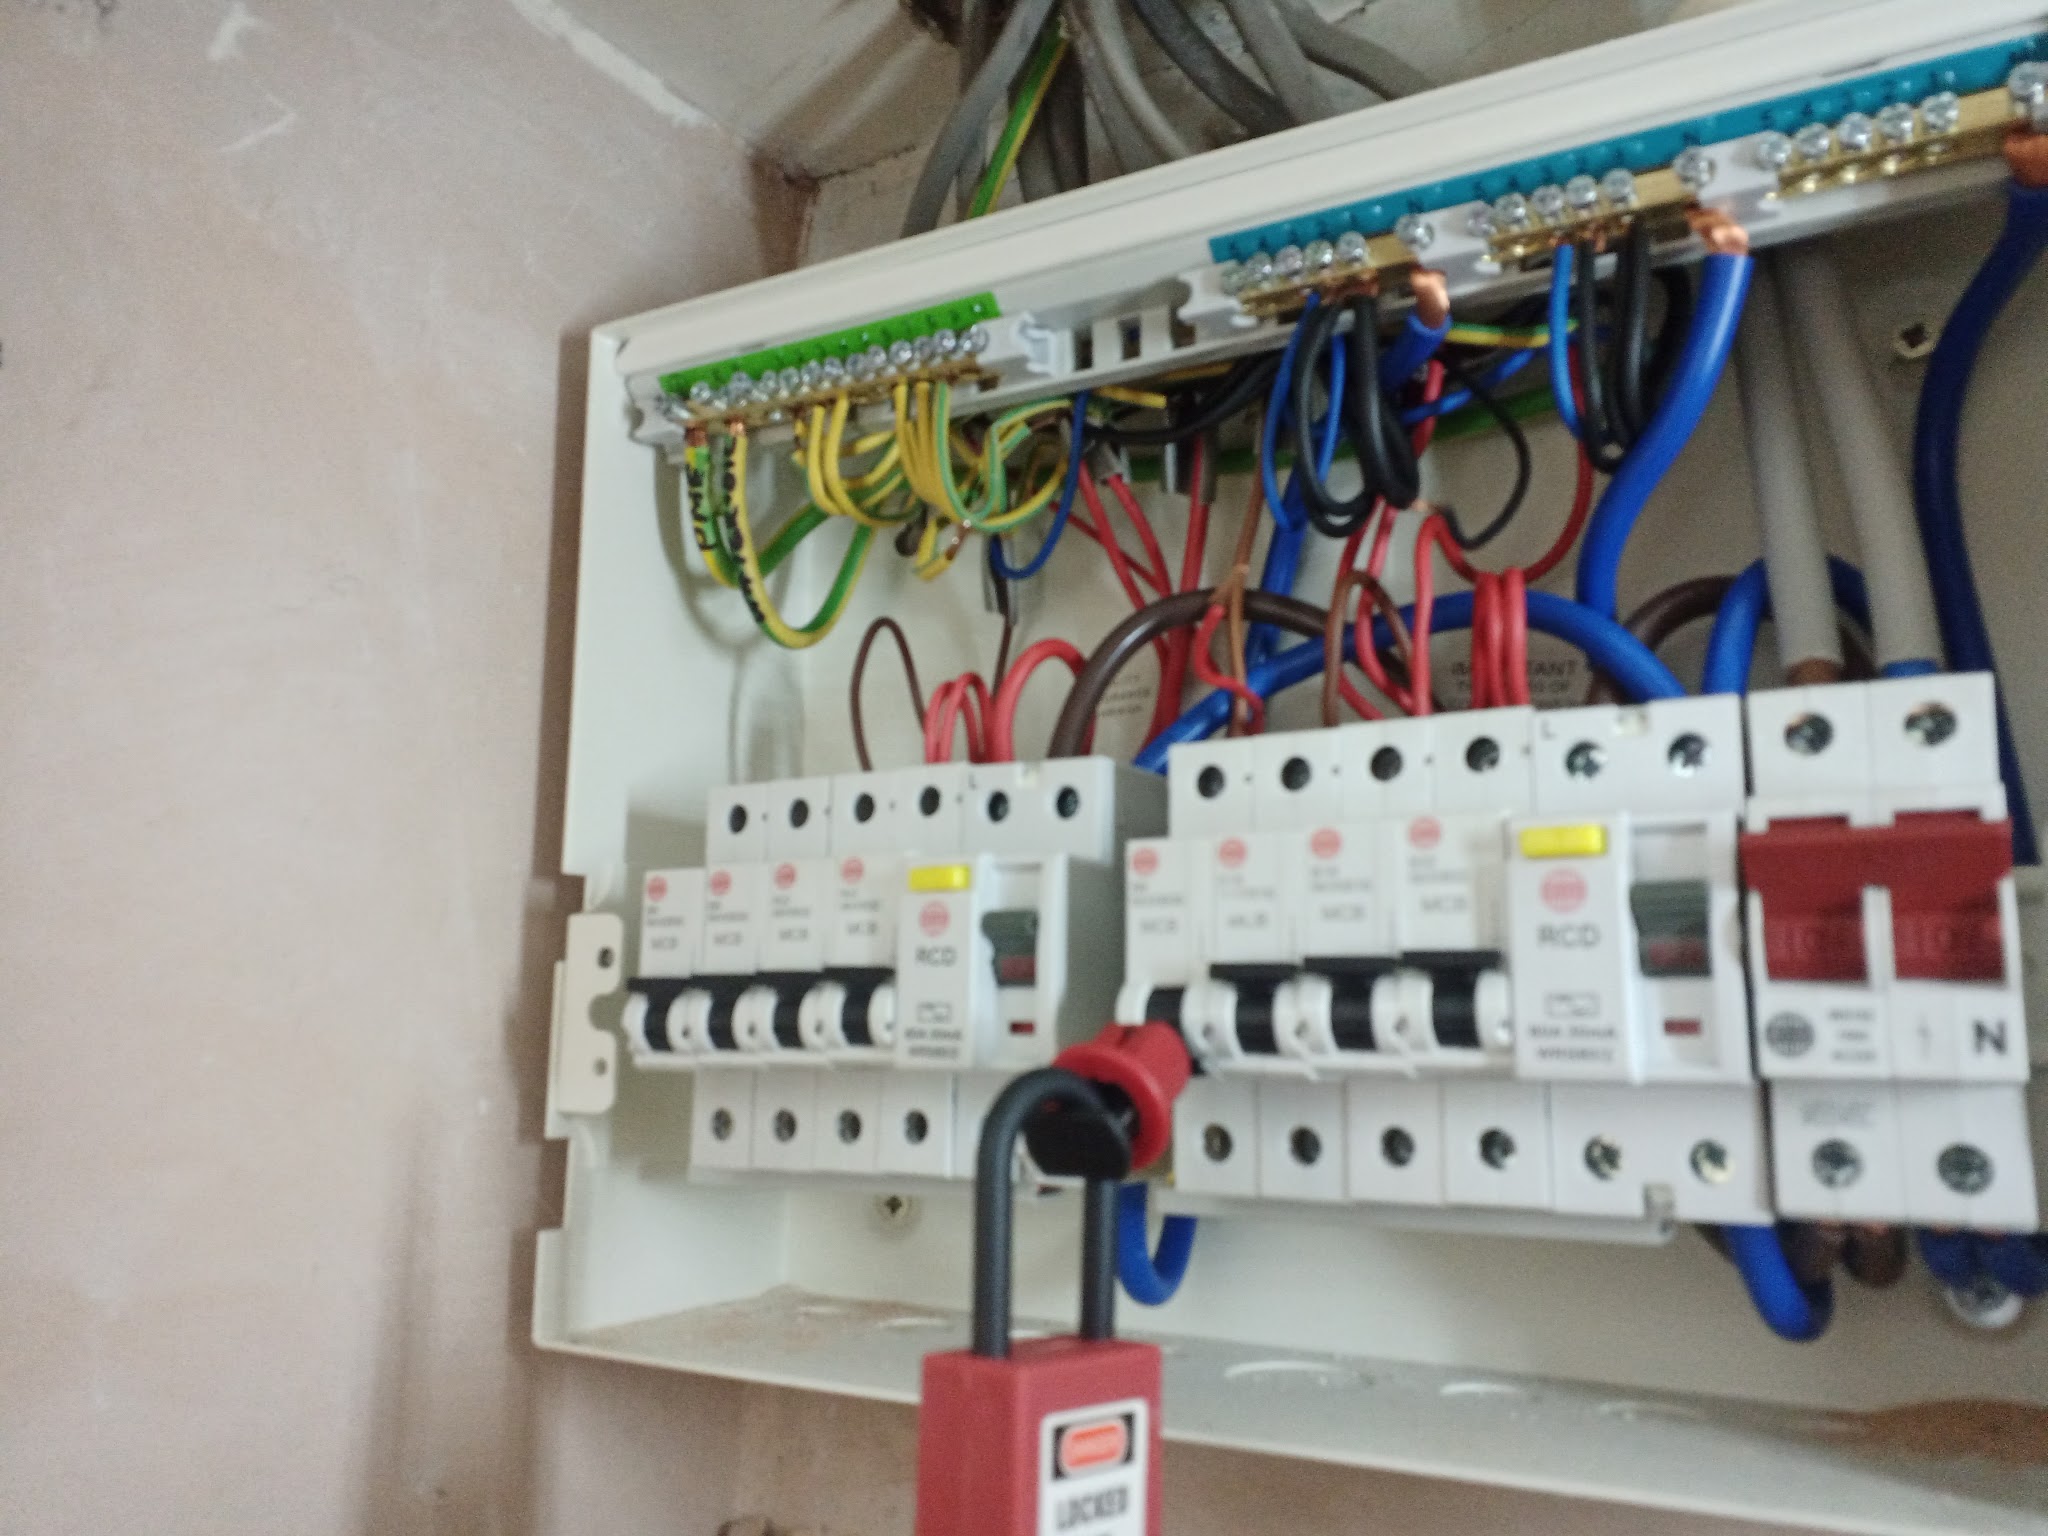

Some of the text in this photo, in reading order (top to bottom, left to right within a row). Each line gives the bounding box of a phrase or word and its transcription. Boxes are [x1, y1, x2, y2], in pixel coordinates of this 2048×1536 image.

[1537, 923, 1602, 949] RCD
[915, 945, 958, 968] RCD
[1972, 1016, 2008, 1056] N
[1056, 1484, 1129, 1530] LOCKED
